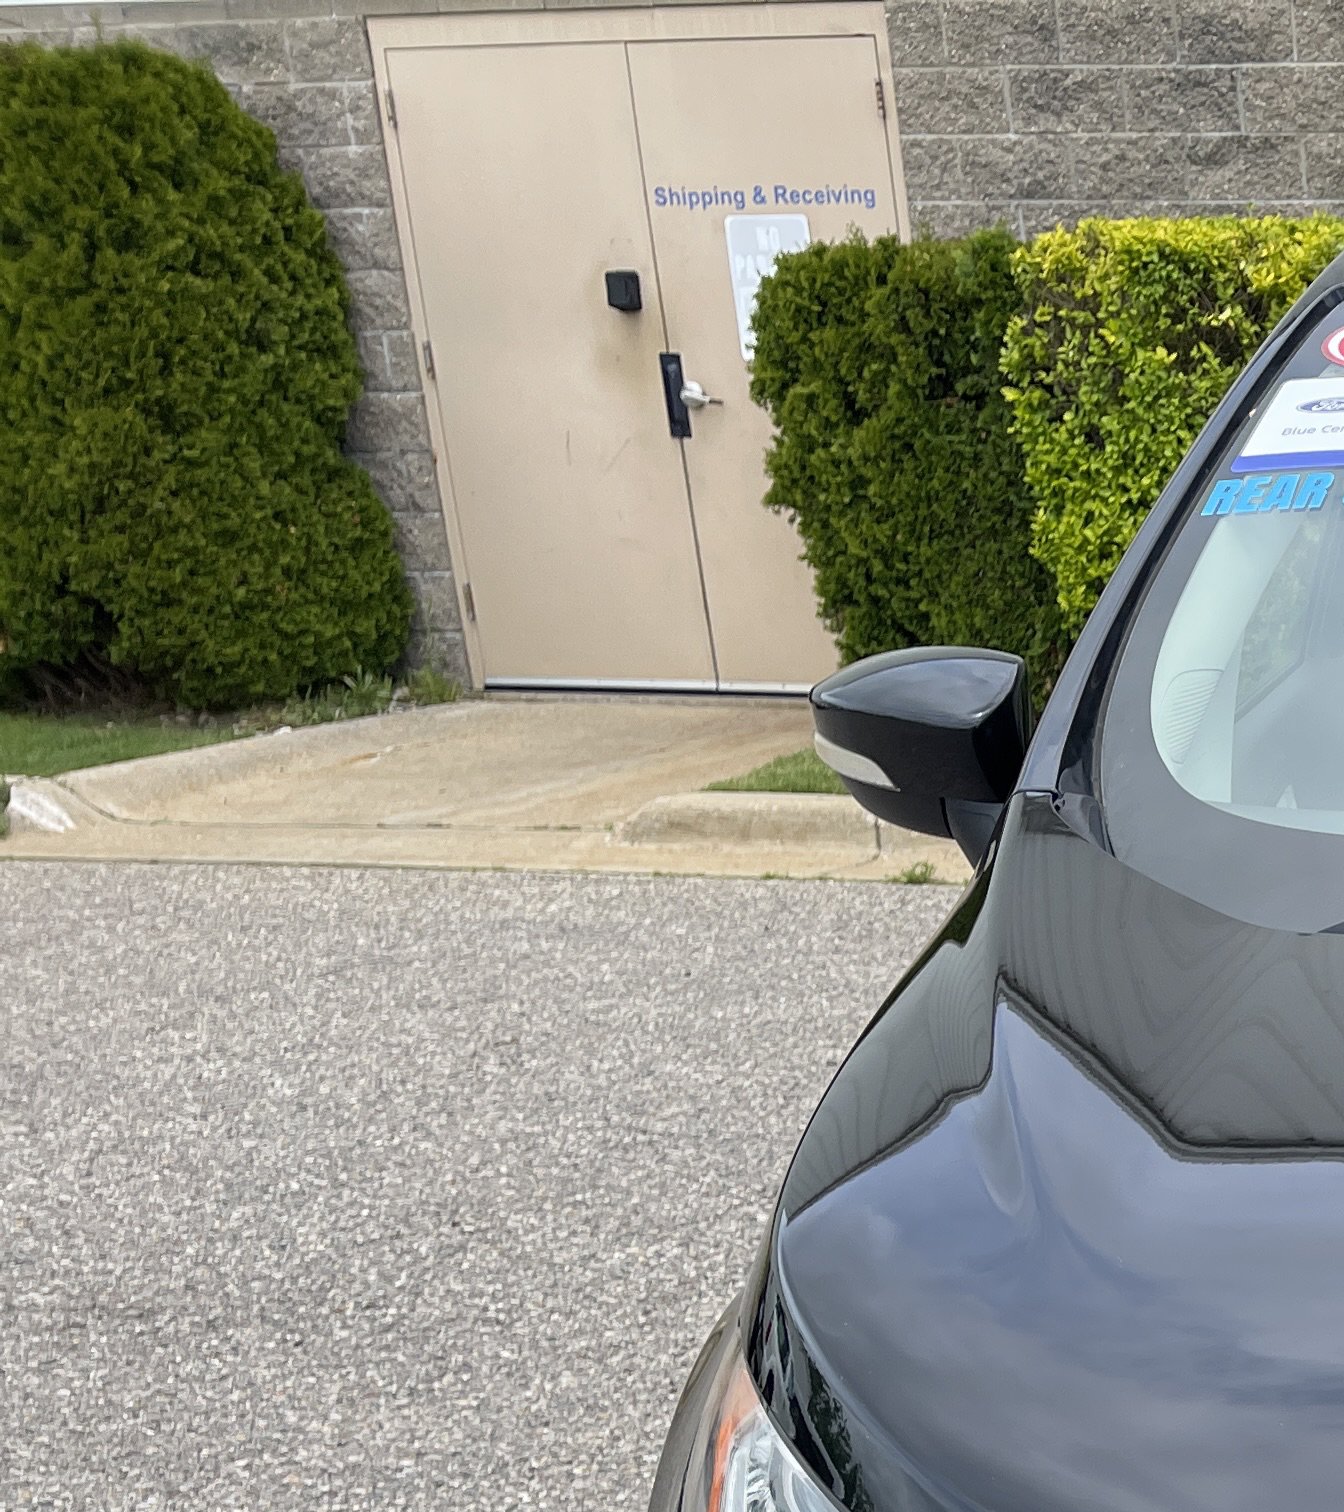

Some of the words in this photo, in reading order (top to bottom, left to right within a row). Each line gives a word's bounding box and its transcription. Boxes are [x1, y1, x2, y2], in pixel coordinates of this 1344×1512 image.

[654, 185, 746, 210] Shipping
[753, 185, 767, 206] &
[774, 184, 876, 209] Receiving
[756, 225, 781, 251] NO
[1281, 426, 1317, 436] Blue
[1200, 471, 1335, 517] REAR
